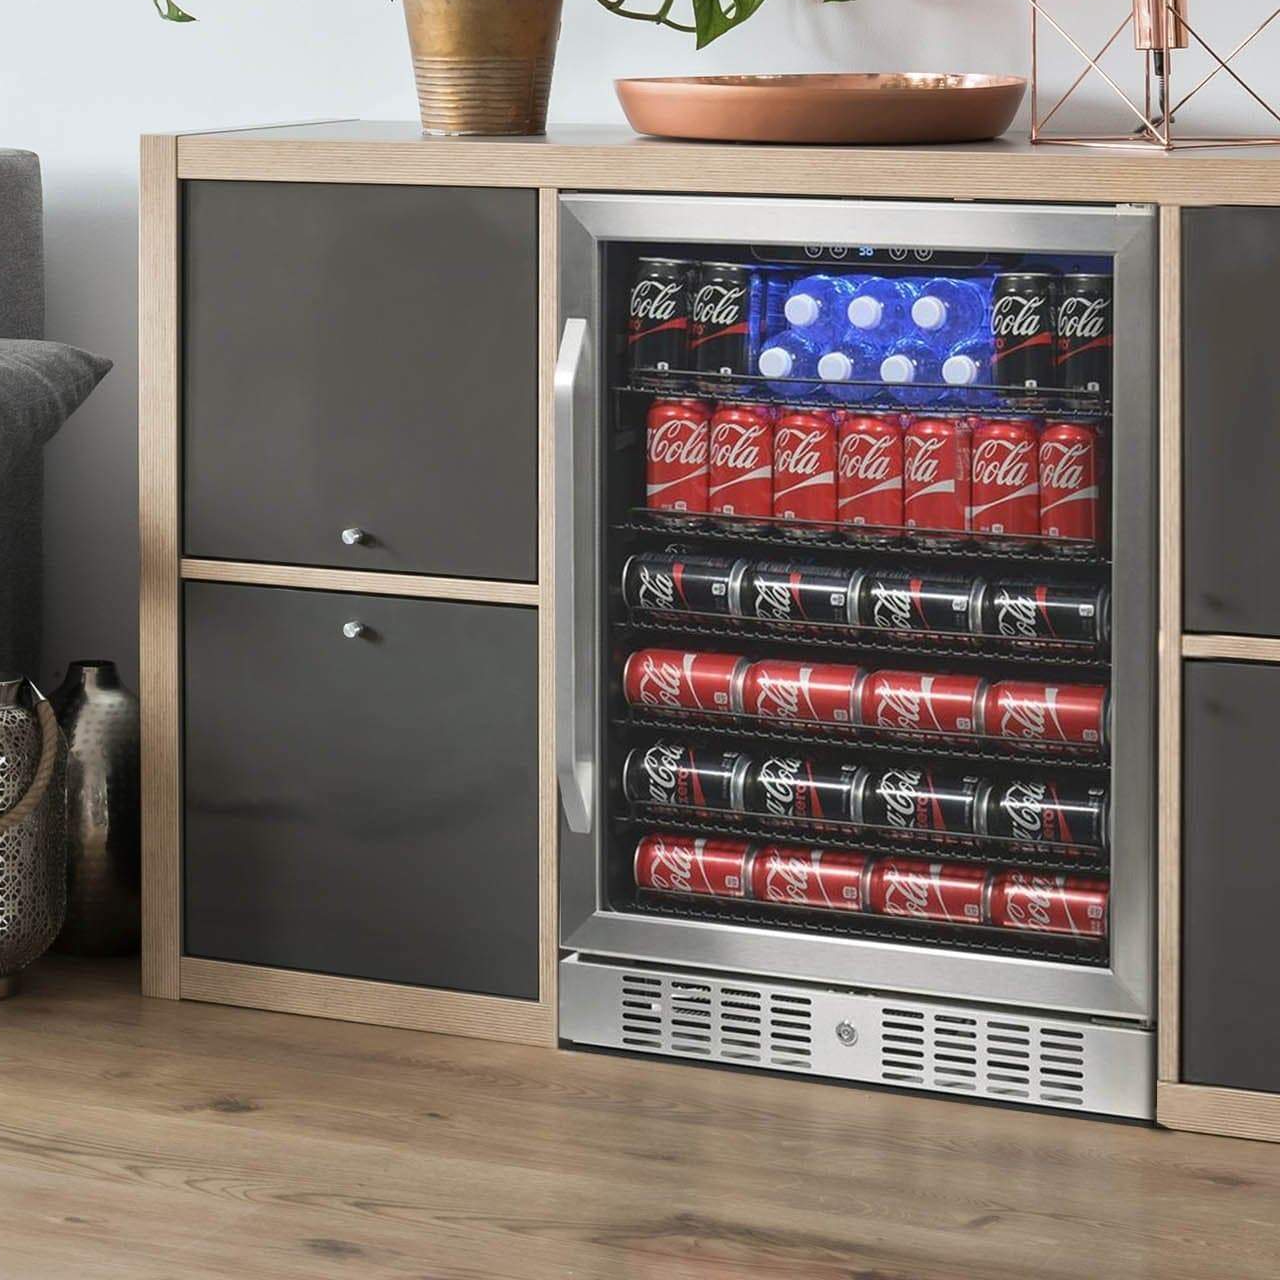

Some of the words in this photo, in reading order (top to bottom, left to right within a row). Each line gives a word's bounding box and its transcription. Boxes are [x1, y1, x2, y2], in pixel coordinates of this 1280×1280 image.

[631, 280, 683, 320] Cola
[693, 285, 747, 325] Cola
[990, 296, 1046, 336] Cola
[1057, 296, 1111, 337] Cola
[650, 419, 708, 464] Cola
[972, 439, 1034, 487] Cola
